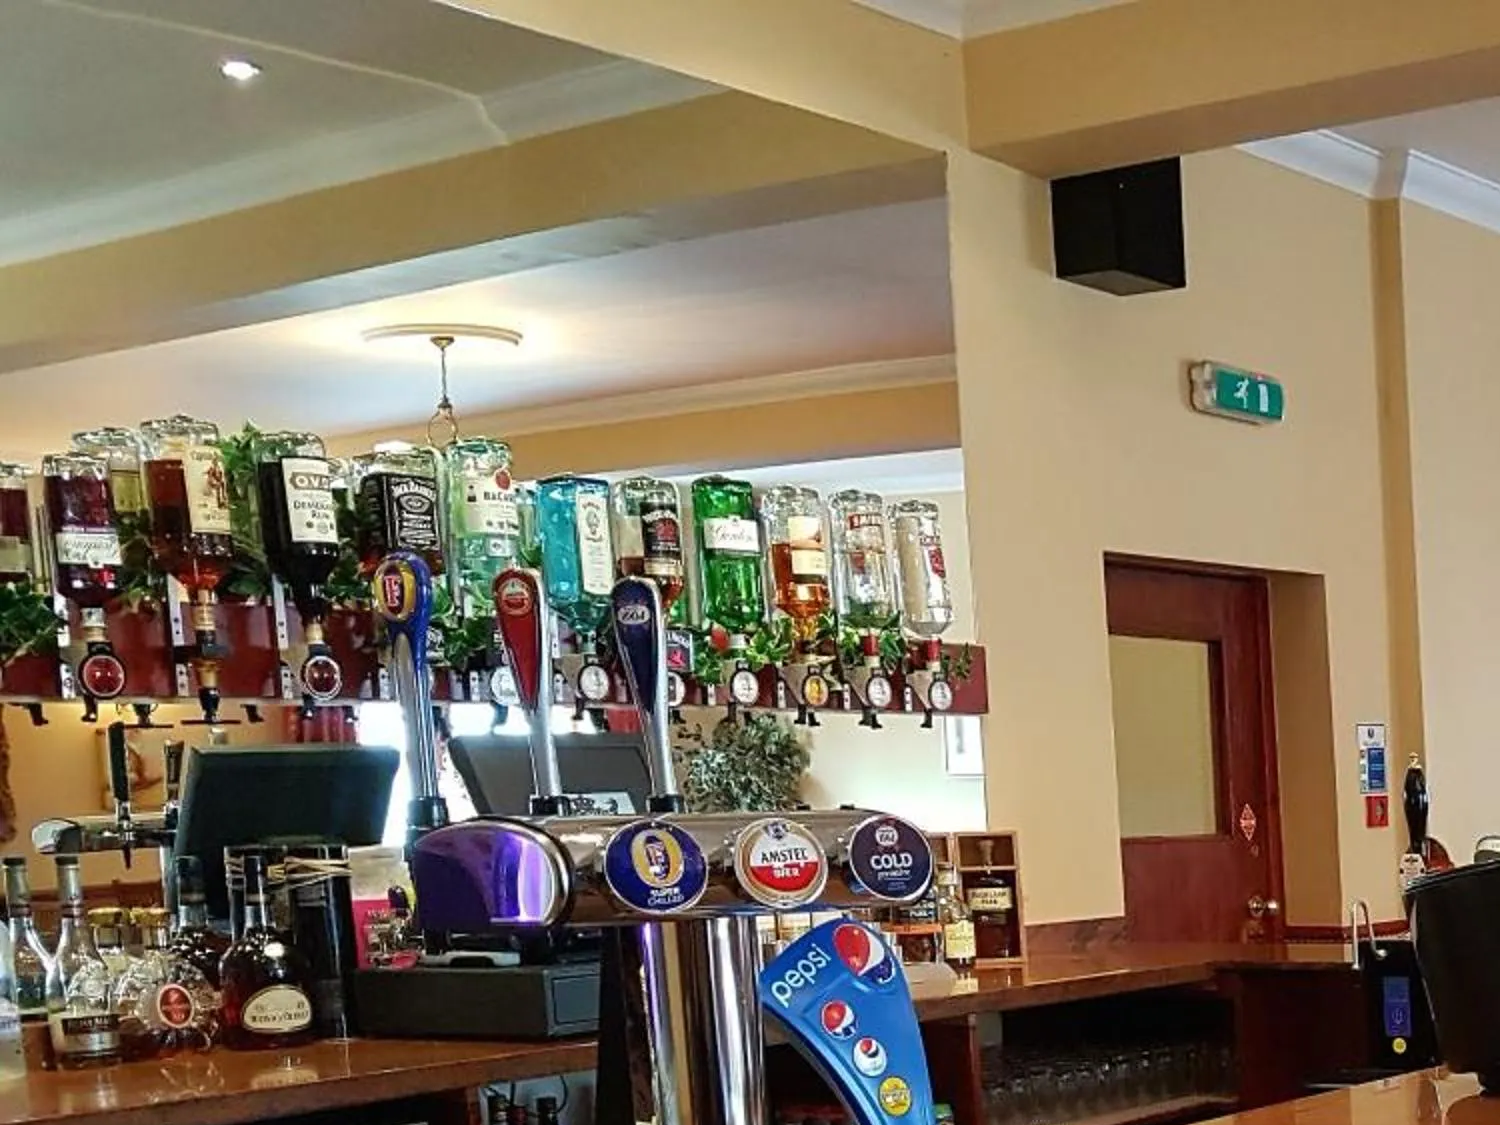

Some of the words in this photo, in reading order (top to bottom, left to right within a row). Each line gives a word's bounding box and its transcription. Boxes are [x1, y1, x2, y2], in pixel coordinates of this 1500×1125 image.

[761, 847, 809, 865] AMSTEL
[870, 852, 913, 870] COLD
[771, 942, 832, 1009] pepsi
